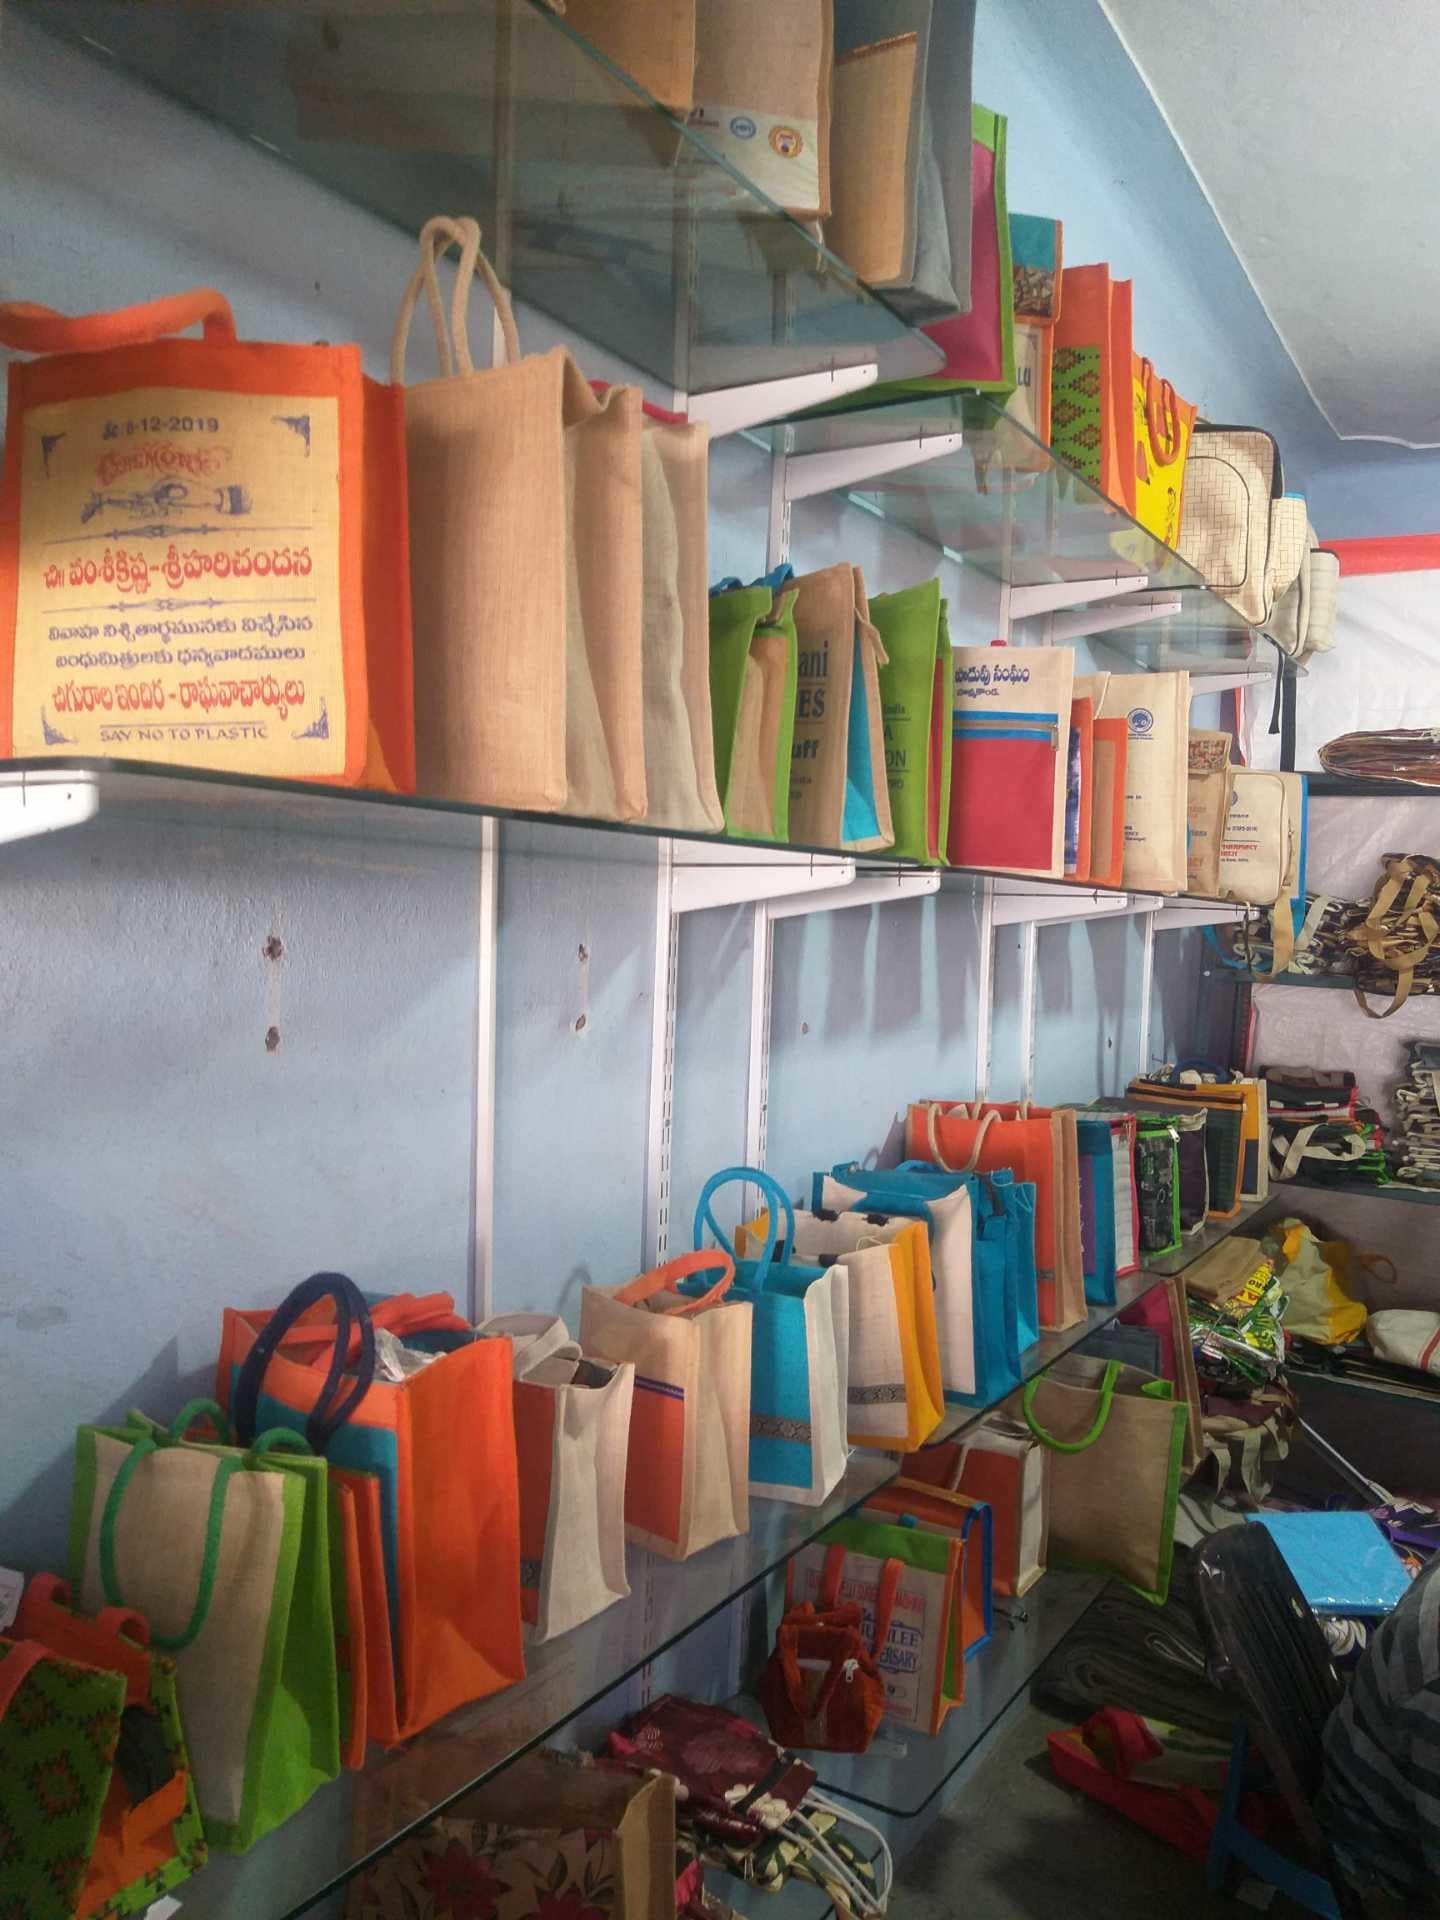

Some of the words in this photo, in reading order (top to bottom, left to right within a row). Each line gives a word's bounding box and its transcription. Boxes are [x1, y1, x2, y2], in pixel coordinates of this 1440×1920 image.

[799, 640, 828, 677] ani
[798, 688, 826, 718] ES
[100, 729, 131, 743] SAY
[138, 728, 164, 742] NO
[168, 728, 191, 742] TO
[195, 725, 268, 741] PLASTIC
[886, 749, 906, 768] ON
